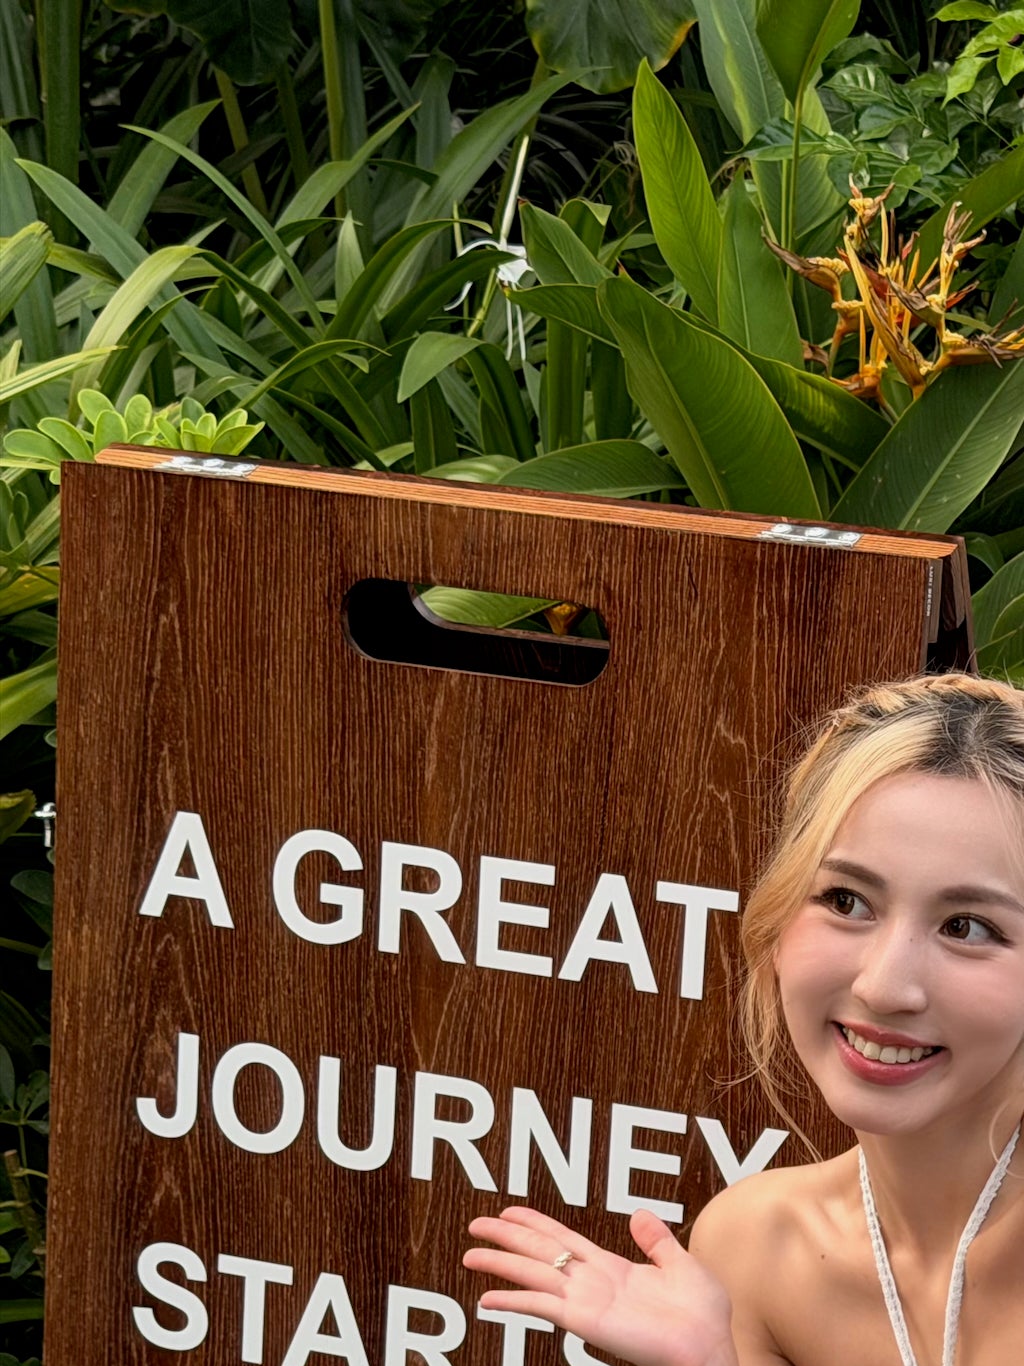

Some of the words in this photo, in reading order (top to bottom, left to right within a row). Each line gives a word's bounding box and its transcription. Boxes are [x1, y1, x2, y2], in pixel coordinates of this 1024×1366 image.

[139, 811, 234, 929] A
[272, 829, 740, 1000] GREAT
[136, 1032, 790, 1224] JOURNEY
